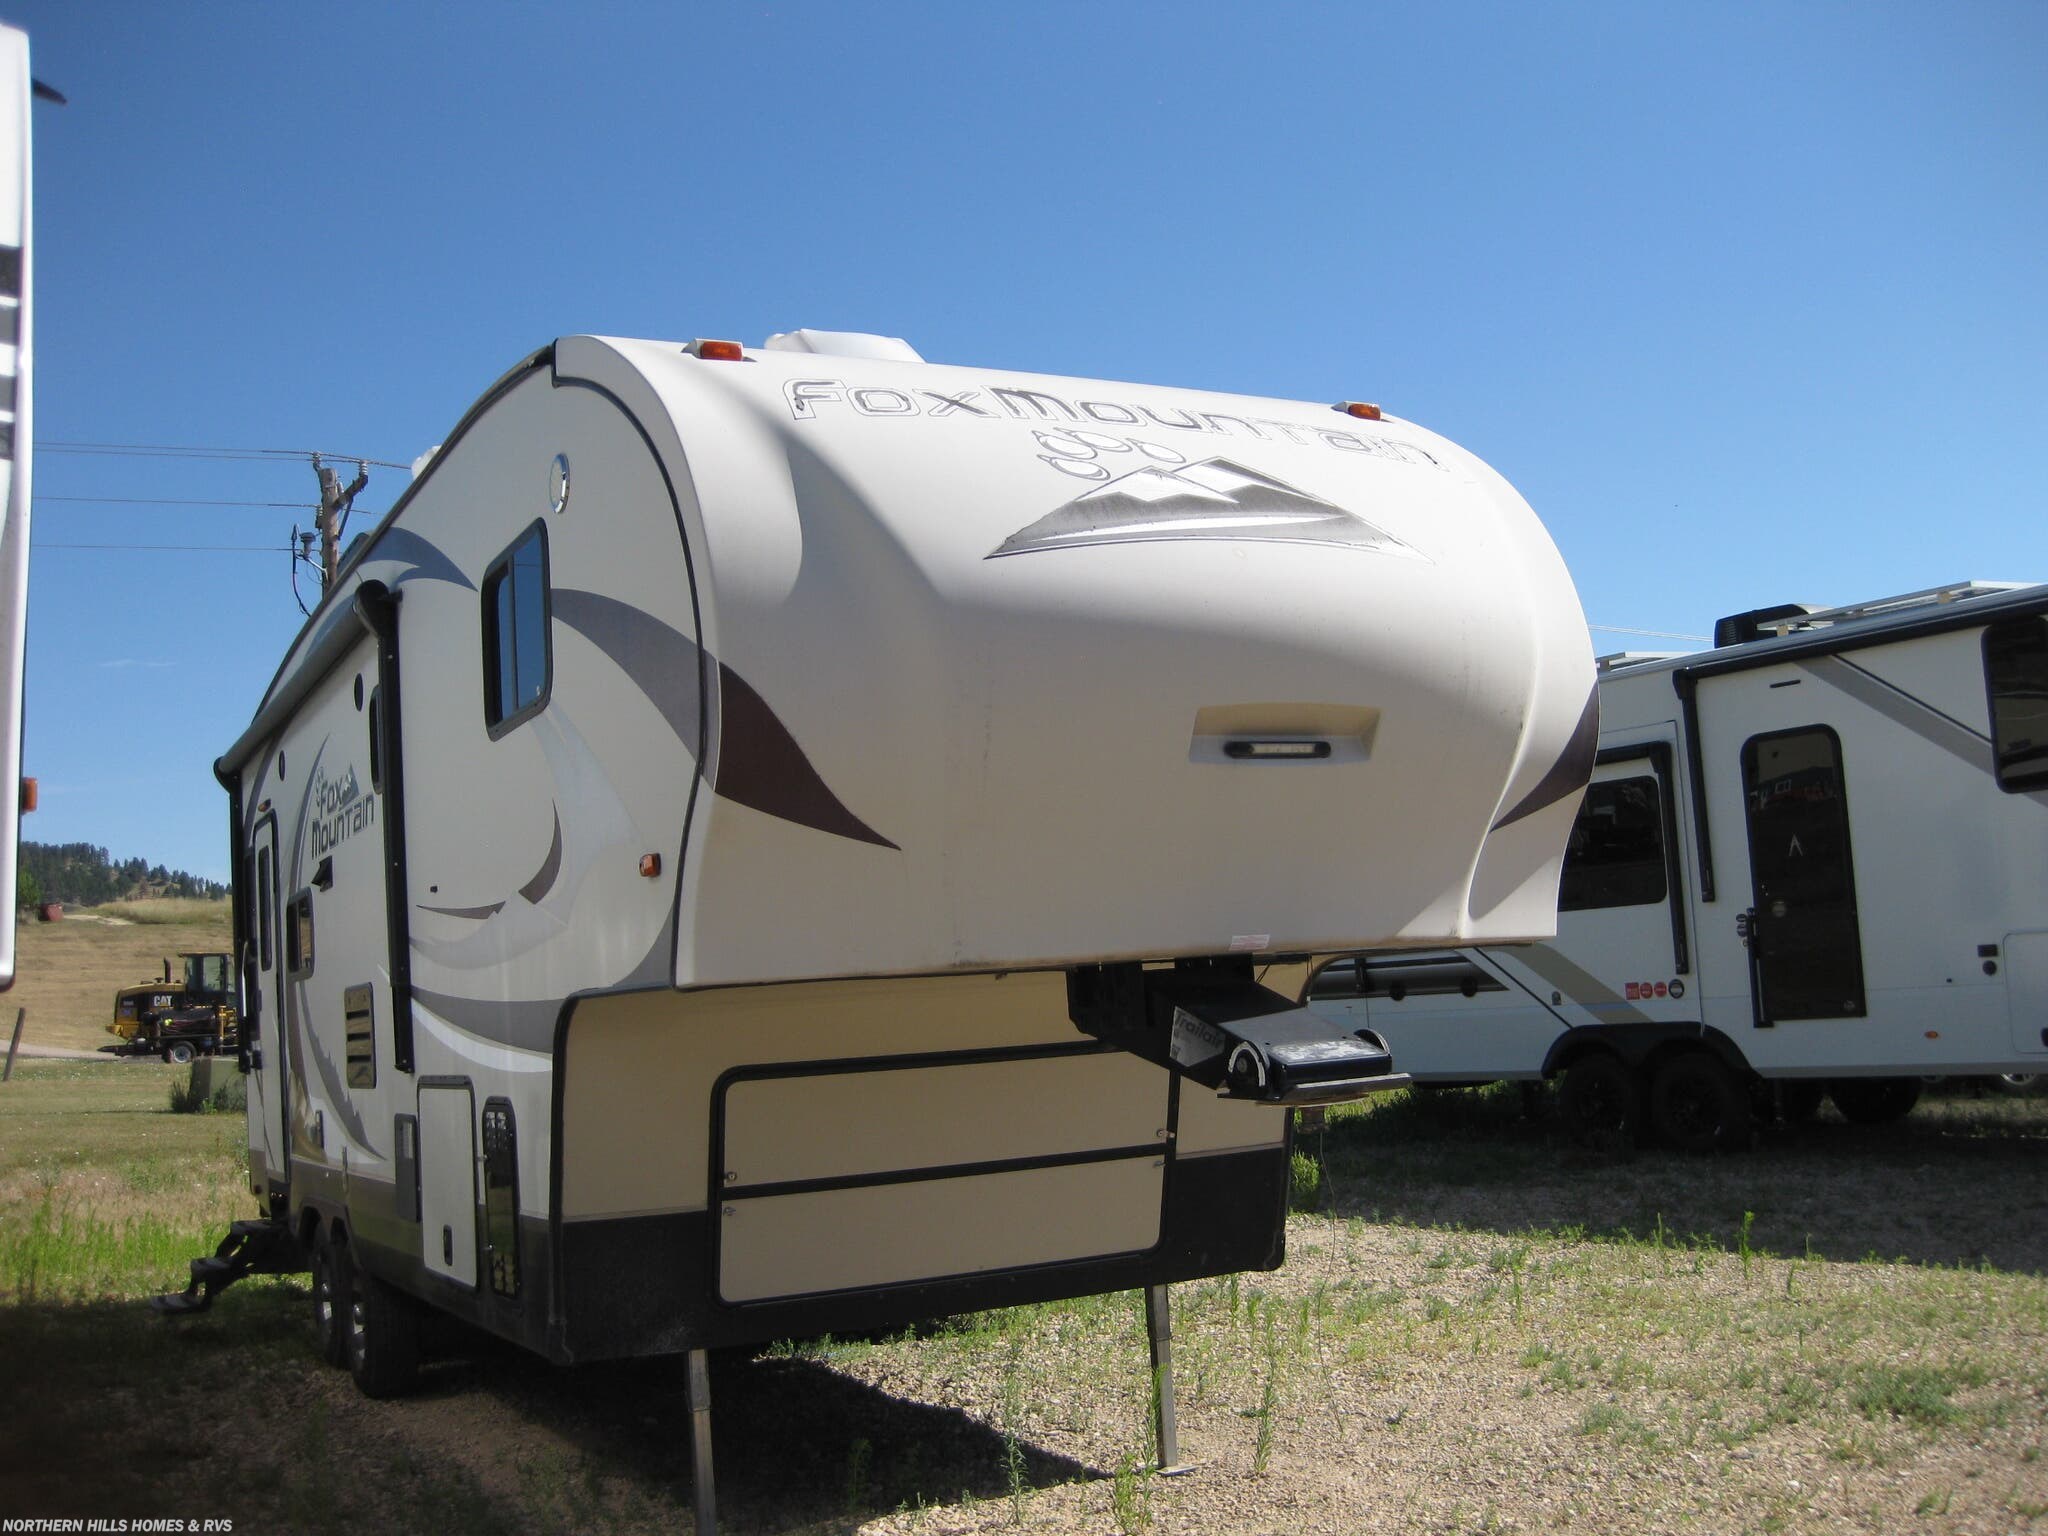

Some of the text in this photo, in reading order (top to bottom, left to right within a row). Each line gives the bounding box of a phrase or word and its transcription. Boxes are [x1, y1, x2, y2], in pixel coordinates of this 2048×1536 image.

[320, 778, 343, 821] Fox
[311, 793, 375, 861] Mountain
[153, 995, 173, 1007] CAT
